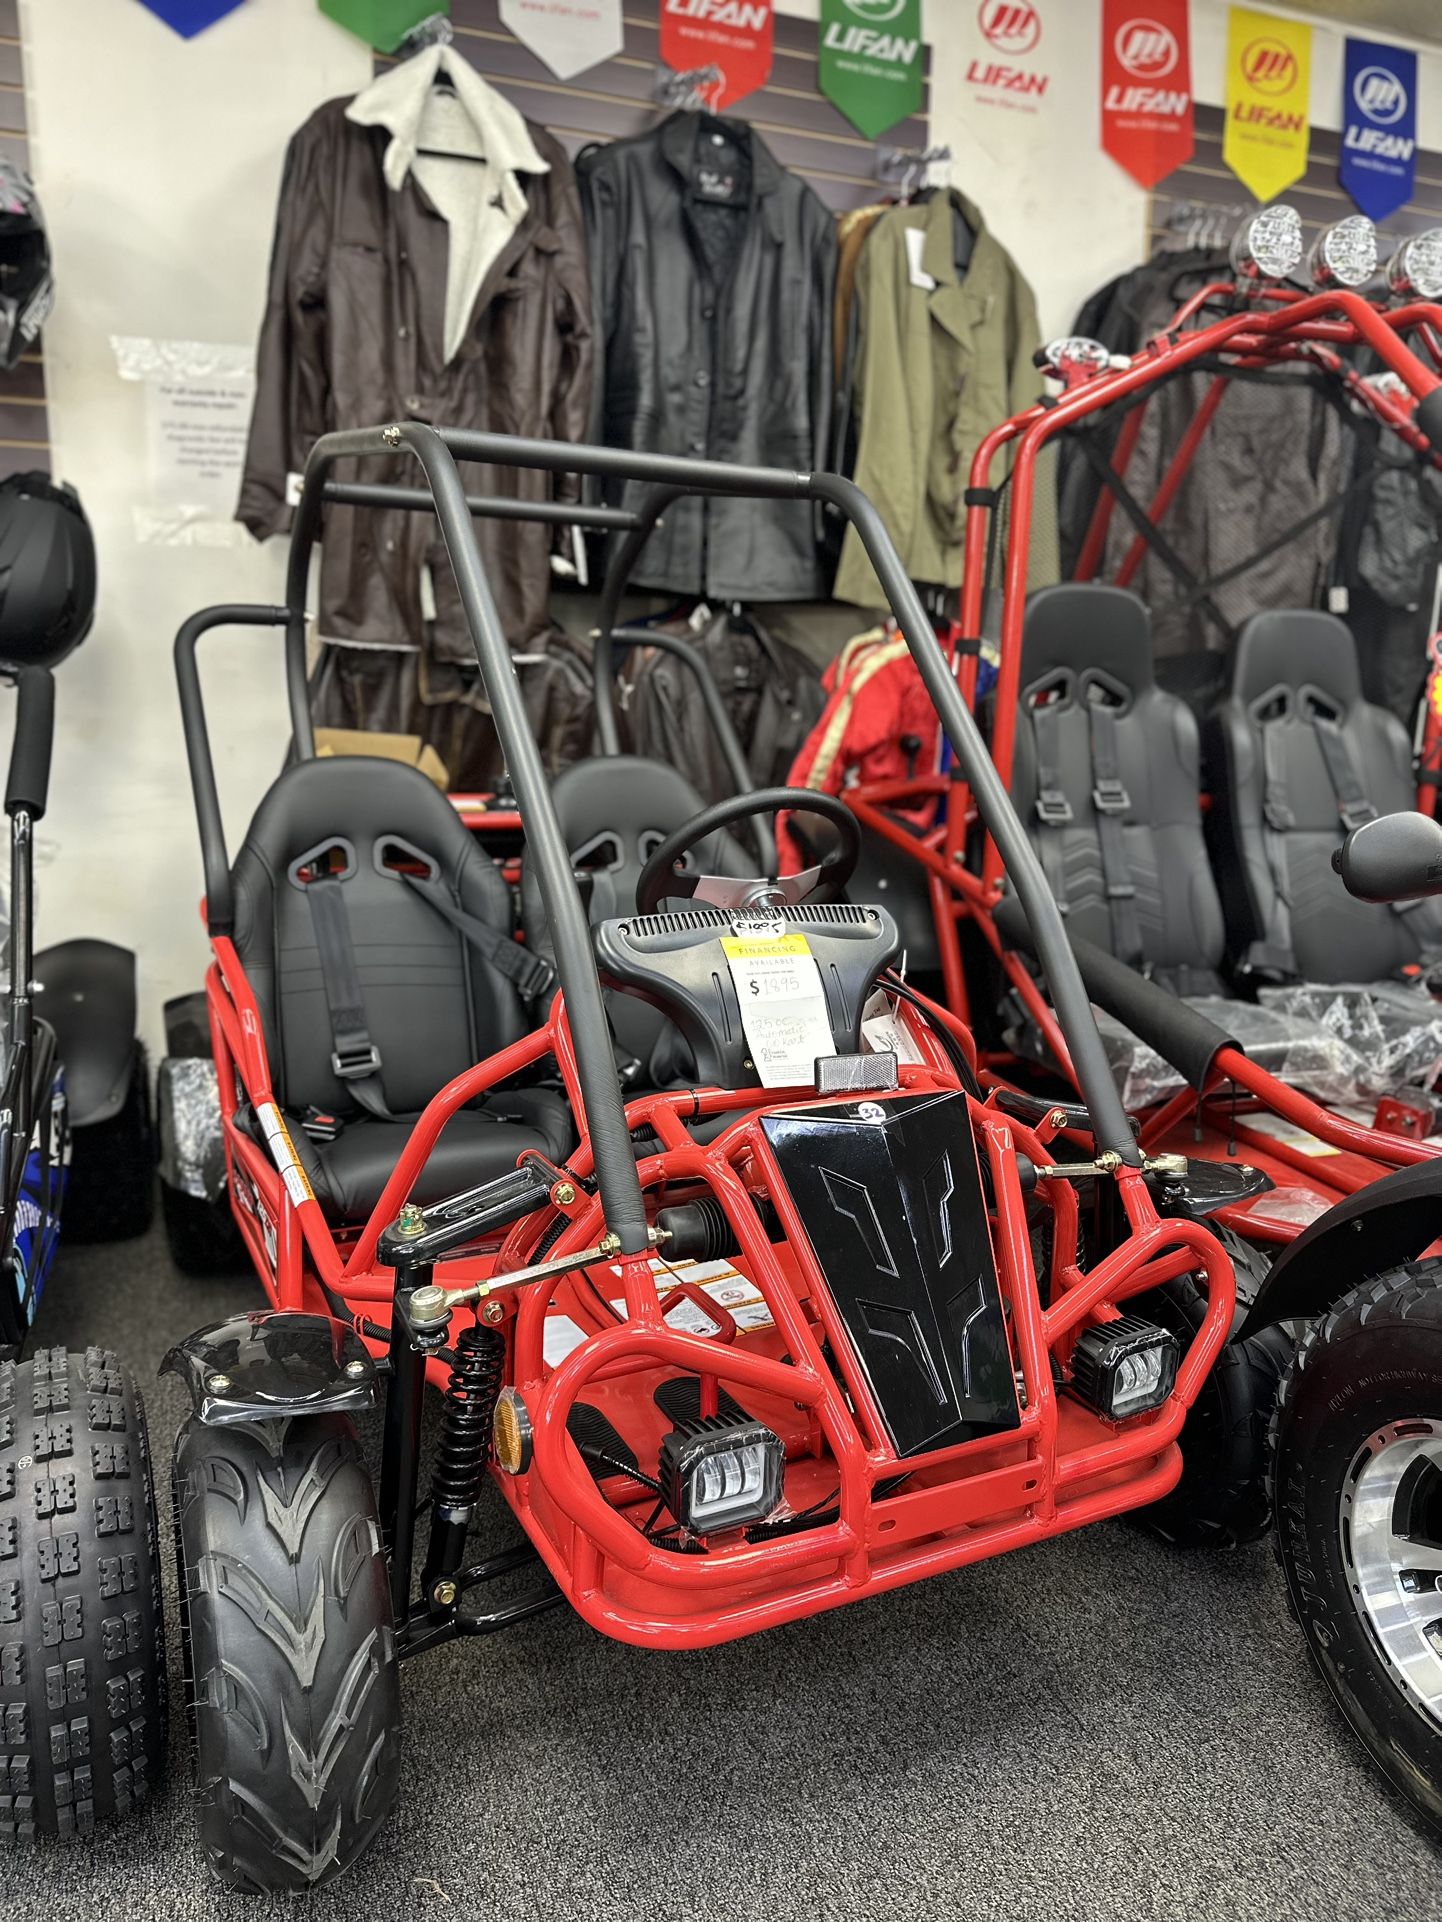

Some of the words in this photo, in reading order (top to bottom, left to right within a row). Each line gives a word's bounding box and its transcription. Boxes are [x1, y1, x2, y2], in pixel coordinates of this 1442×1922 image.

[665, 0, 767, 31] LIFAN
[824, 22, 917, 65] LIFAN
[966, 60, 1049, 97] LIFAN
[1105, 85, 1189, 117] LIFAN
[1234, 102, 1304, 133] LIFAN
[1344, 125, 1414, 162] LIFAN
[738, 945, 797, 955] FINANCING
[749, 957, 795, 967] AVAILABLE
[1287, 1477, 1327, 1612] JUNKAI
